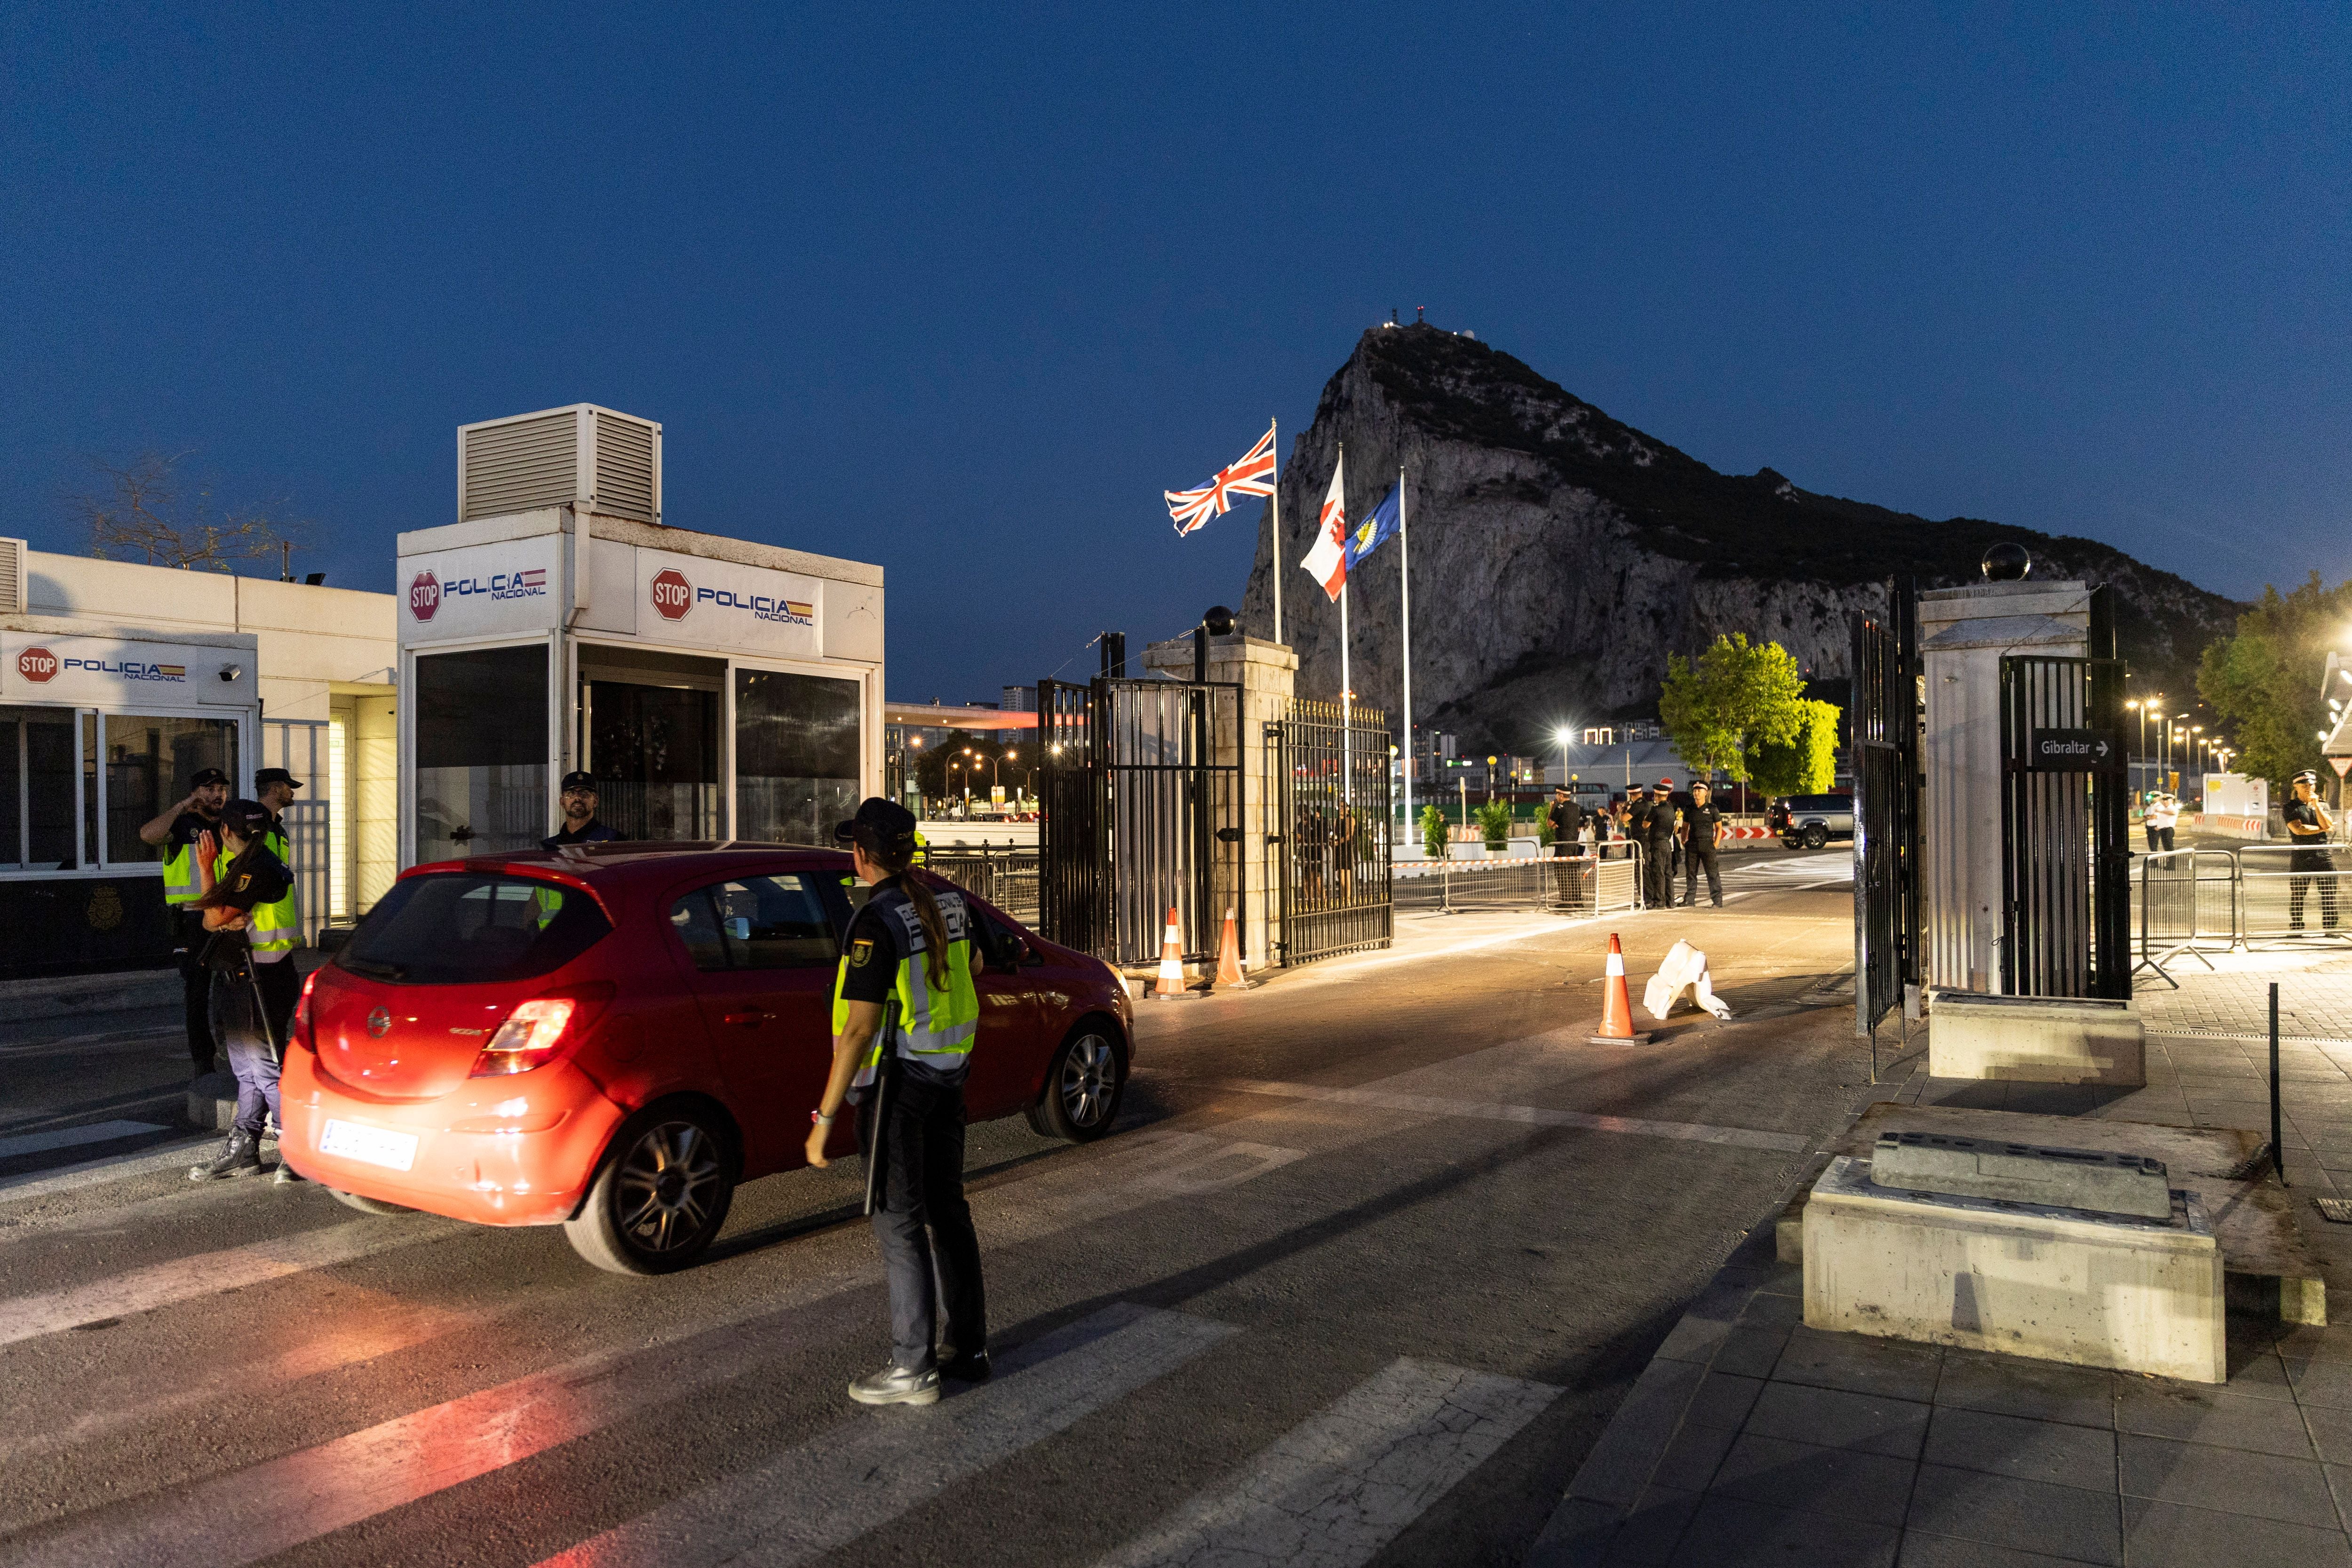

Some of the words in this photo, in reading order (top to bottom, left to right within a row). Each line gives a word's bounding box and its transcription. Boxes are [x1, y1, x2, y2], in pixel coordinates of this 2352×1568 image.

[413, 585, 437, 607] STOP
[492, 587, 546, 600] NACIONAL
[656, 582, 688, 606] STOP
[755, 612, 812, 626] NACIONAL
[21, 657, 56, 673] STOP
[124, 673, 185, 682] NACIONAL
[2042, 740, 2090, 754] Gibraltar
